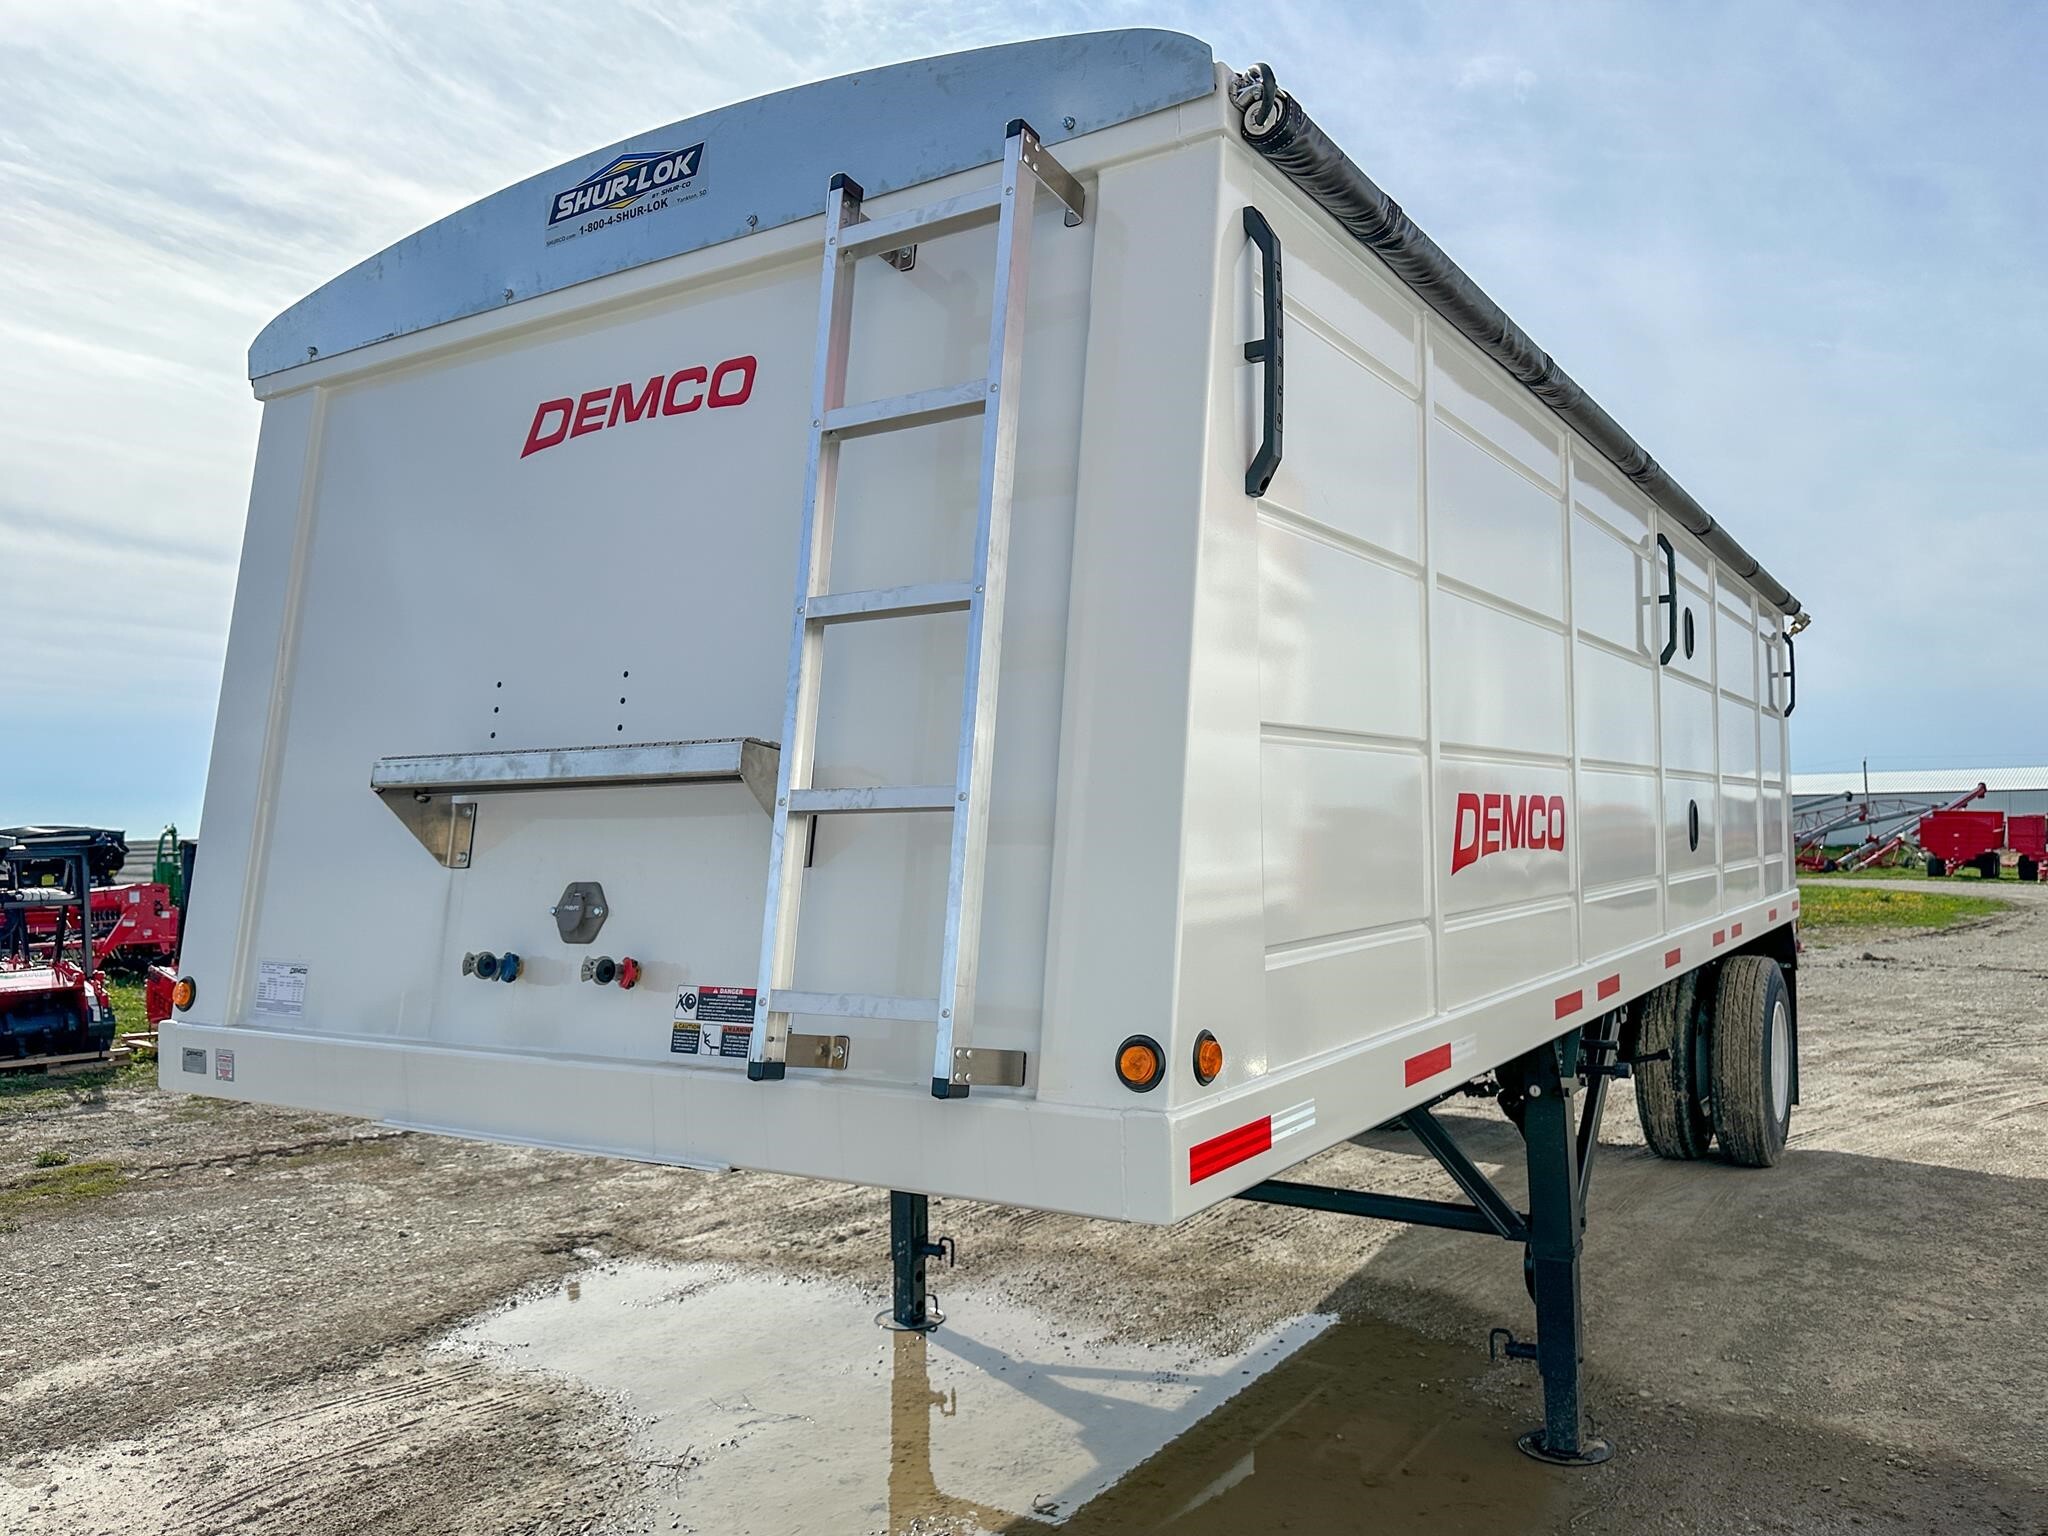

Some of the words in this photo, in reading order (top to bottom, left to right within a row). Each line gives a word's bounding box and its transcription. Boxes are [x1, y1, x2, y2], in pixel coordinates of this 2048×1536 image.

[555, 150, 696, 220] SHUR-LOK
[578, 197, 669, 236] 1-800-4-SHUR-LOK
[519, 355, 758, 460] DEMCO
[1451, 792, 1565, 876] DEMCO
[719, 987, 744, 996] DANGER
